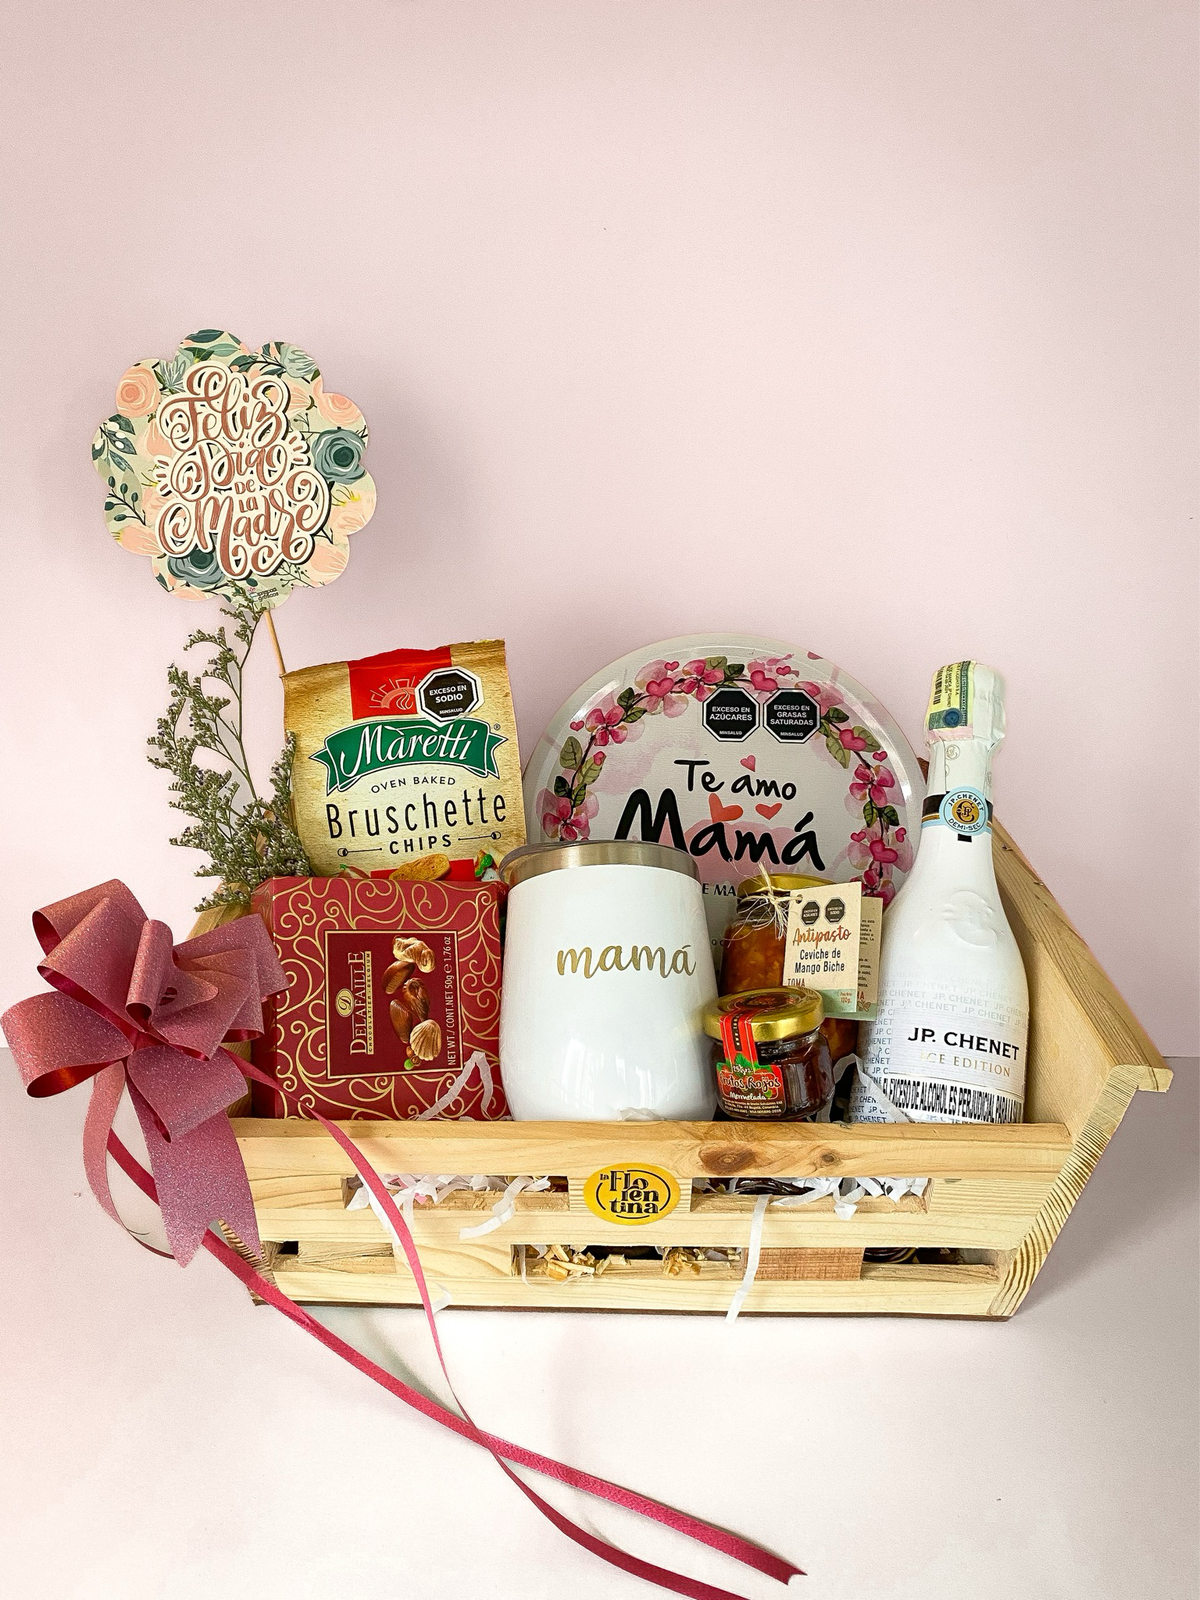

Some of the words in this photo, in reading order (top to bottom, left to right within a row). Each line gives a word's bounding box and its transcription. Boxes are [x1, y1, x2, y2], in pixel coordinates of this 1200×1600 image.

[158, 364, 285, 450] Feliz
[157, 471, 326, 577] Madre
[429, 685, 455, 696] EXCESO
[457, 684, 467, 692] EN
[435, 693, 463, 703] SODIO
[439, 707, 464, 715] MINSALUD
[709, 713, 753, 721] AZÚCARES
[776, 711, 807, 719] GRASAS
[770, 718, 814, 726] SATURADAS
[340, 723, 477, 778] Maretti
[371, 777, 407, 794] OVEN
[413, 775, 456, 786] BAKED
[674, 759, 724, 792] Te
[731, 774, 797, 800] amo
[325, 787, 506, 839] Bruschette
[614, 787, 825, 871] Mamá
[948, 818, 981, 831] DEMI-SEC
[389, 834, 452, 855] CHIPS
[702, 883, 709, 895] E
[714, 884, 736, 897] MA
[444, 936, 451, 945] oz
[792, 925, 851, 949] Antipasto
[443, 946, 452, 962] 1.76
[556, 944, 697, 979] mamá
[800, 949, 829, 960] Ceviche
[832, 948, 841, 959] de
[795, 962, 820, 974] Mango
[823, 961, 845, 972] Biche
[444, 975, 454, 989] 50g
[348, 952, 368, 1055] DELAFAILLE
[949, 994, 989, 1007] CHENET
[915, 1001, 957, 1011] CHENET
[978, 1009, 1012, 1023] CHENET
[908, 1027, 936, 1043] JP.
[944, 1031, 1019, 1061] CHENET
[447, 1050, 456, 1065] NET
[953, 1056, 1011, 1078] EDITION
[918, 1081, 948, 1115] ALCOHOL
[610, 1170, 649, 1191] Flo
[609, 1198, 658, 1213] tina
